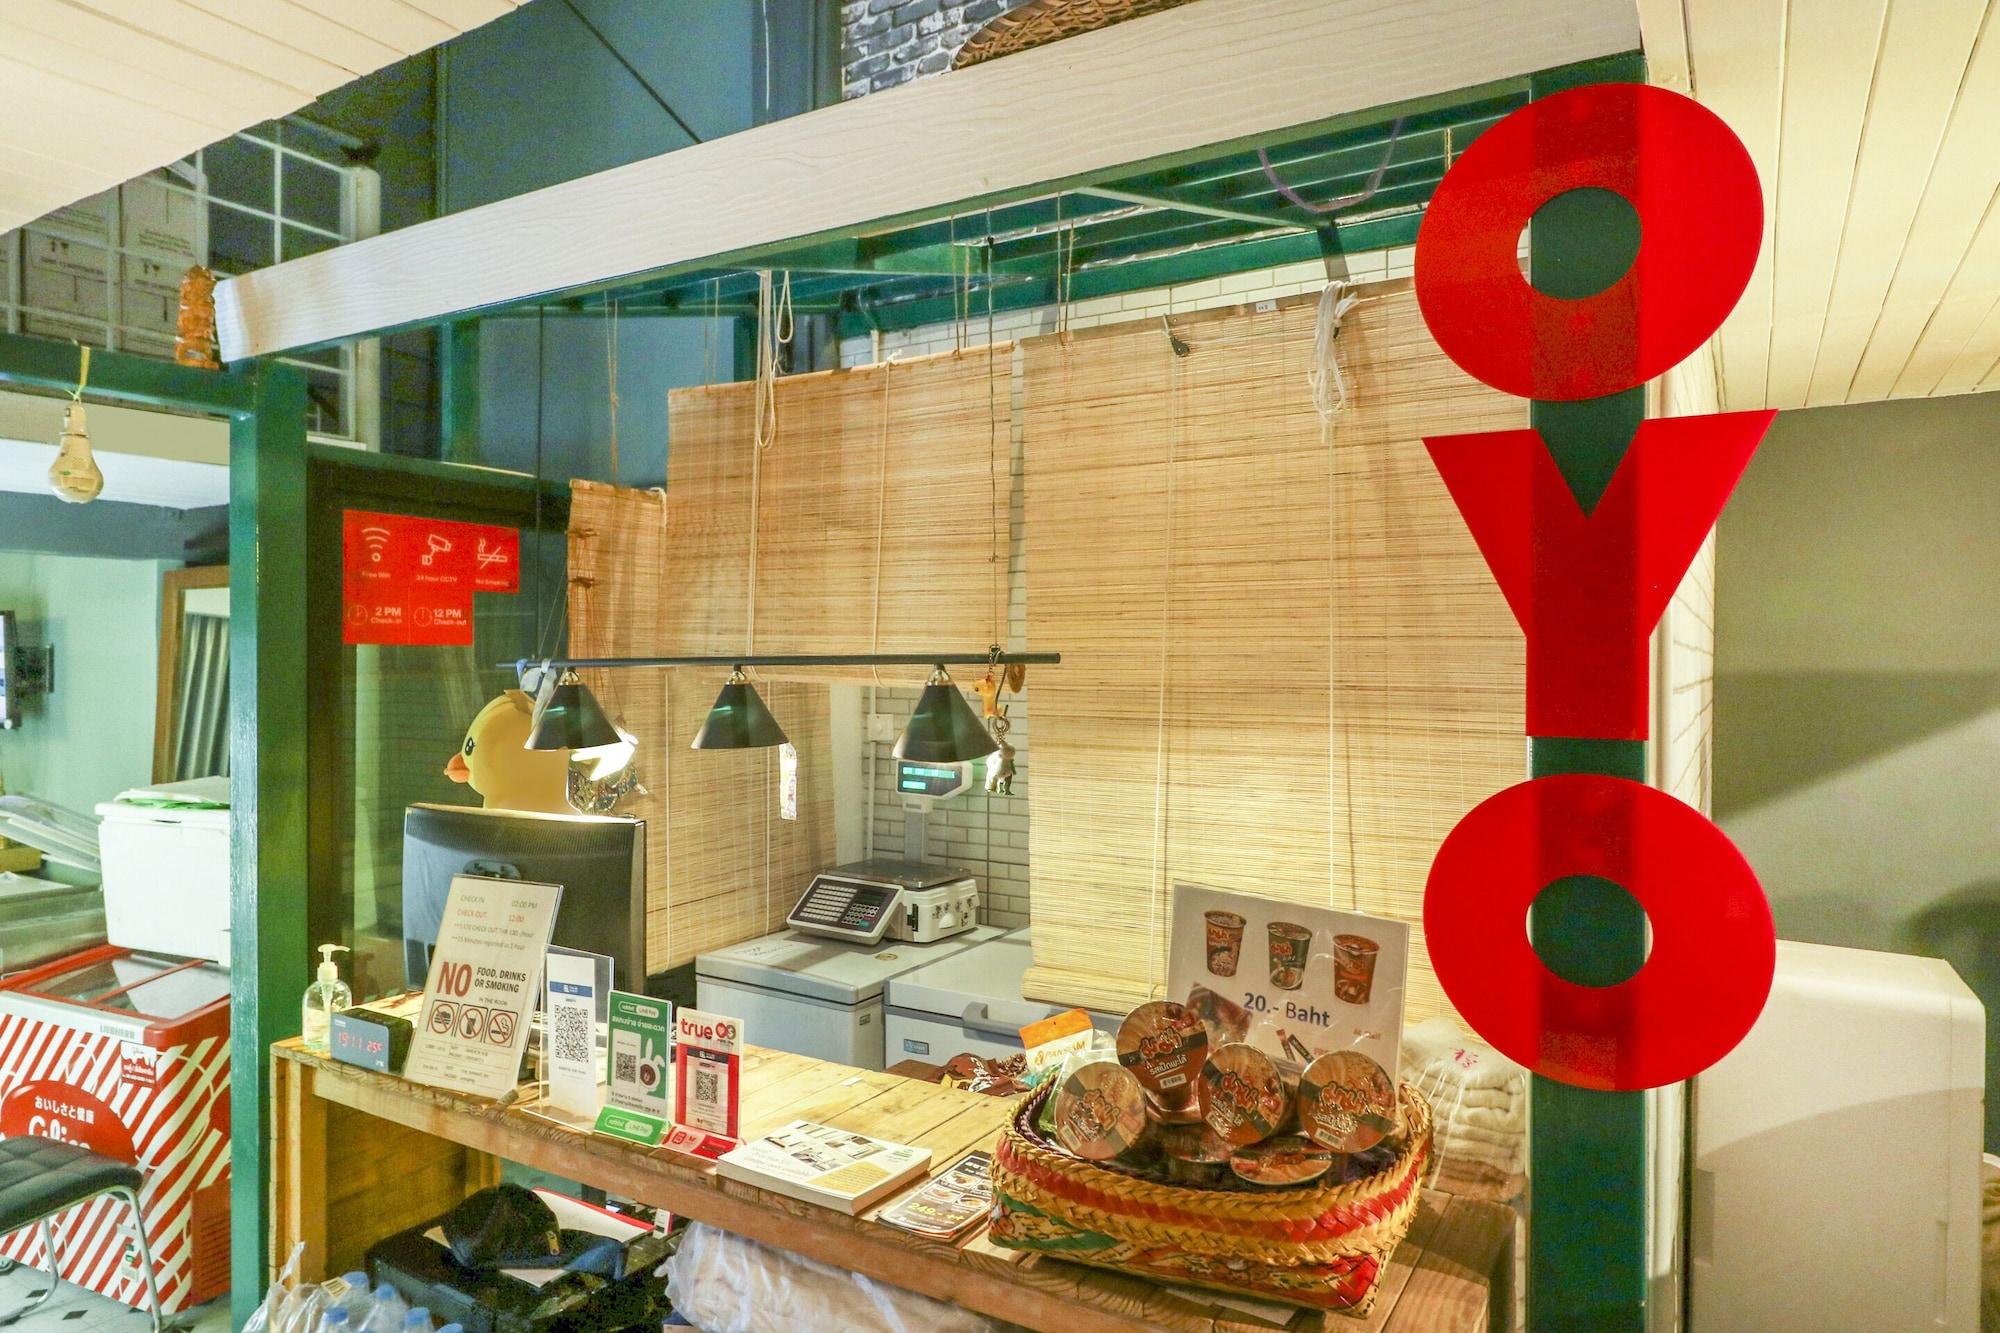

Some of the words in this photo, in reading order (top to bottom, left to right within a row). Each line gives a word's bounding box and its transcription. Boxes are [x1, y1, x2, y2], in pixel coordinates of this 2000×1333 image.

[1414, 82, 1777, 1092] OYO
[375, 606, 382, 617] 2
[384, 607, 402, 617] PM
[433, 608, 443, 618] 12
[445, 609, 462, 619] PM
[433, 618, 467, 626] Check-out
[436, 961, 473, 998] NO
[476, 967, 499, 980] FOOD,
[499, 969, 527, 983] DRINKS
[474, 978, 485, 990] OR
[484, 980, 520, 994] SMOKING
[1243, 991, 1279, 1014] 20.-
[1285, 1001, 1331, 1028] Baht
[680, 1018, 713, 1040] true
